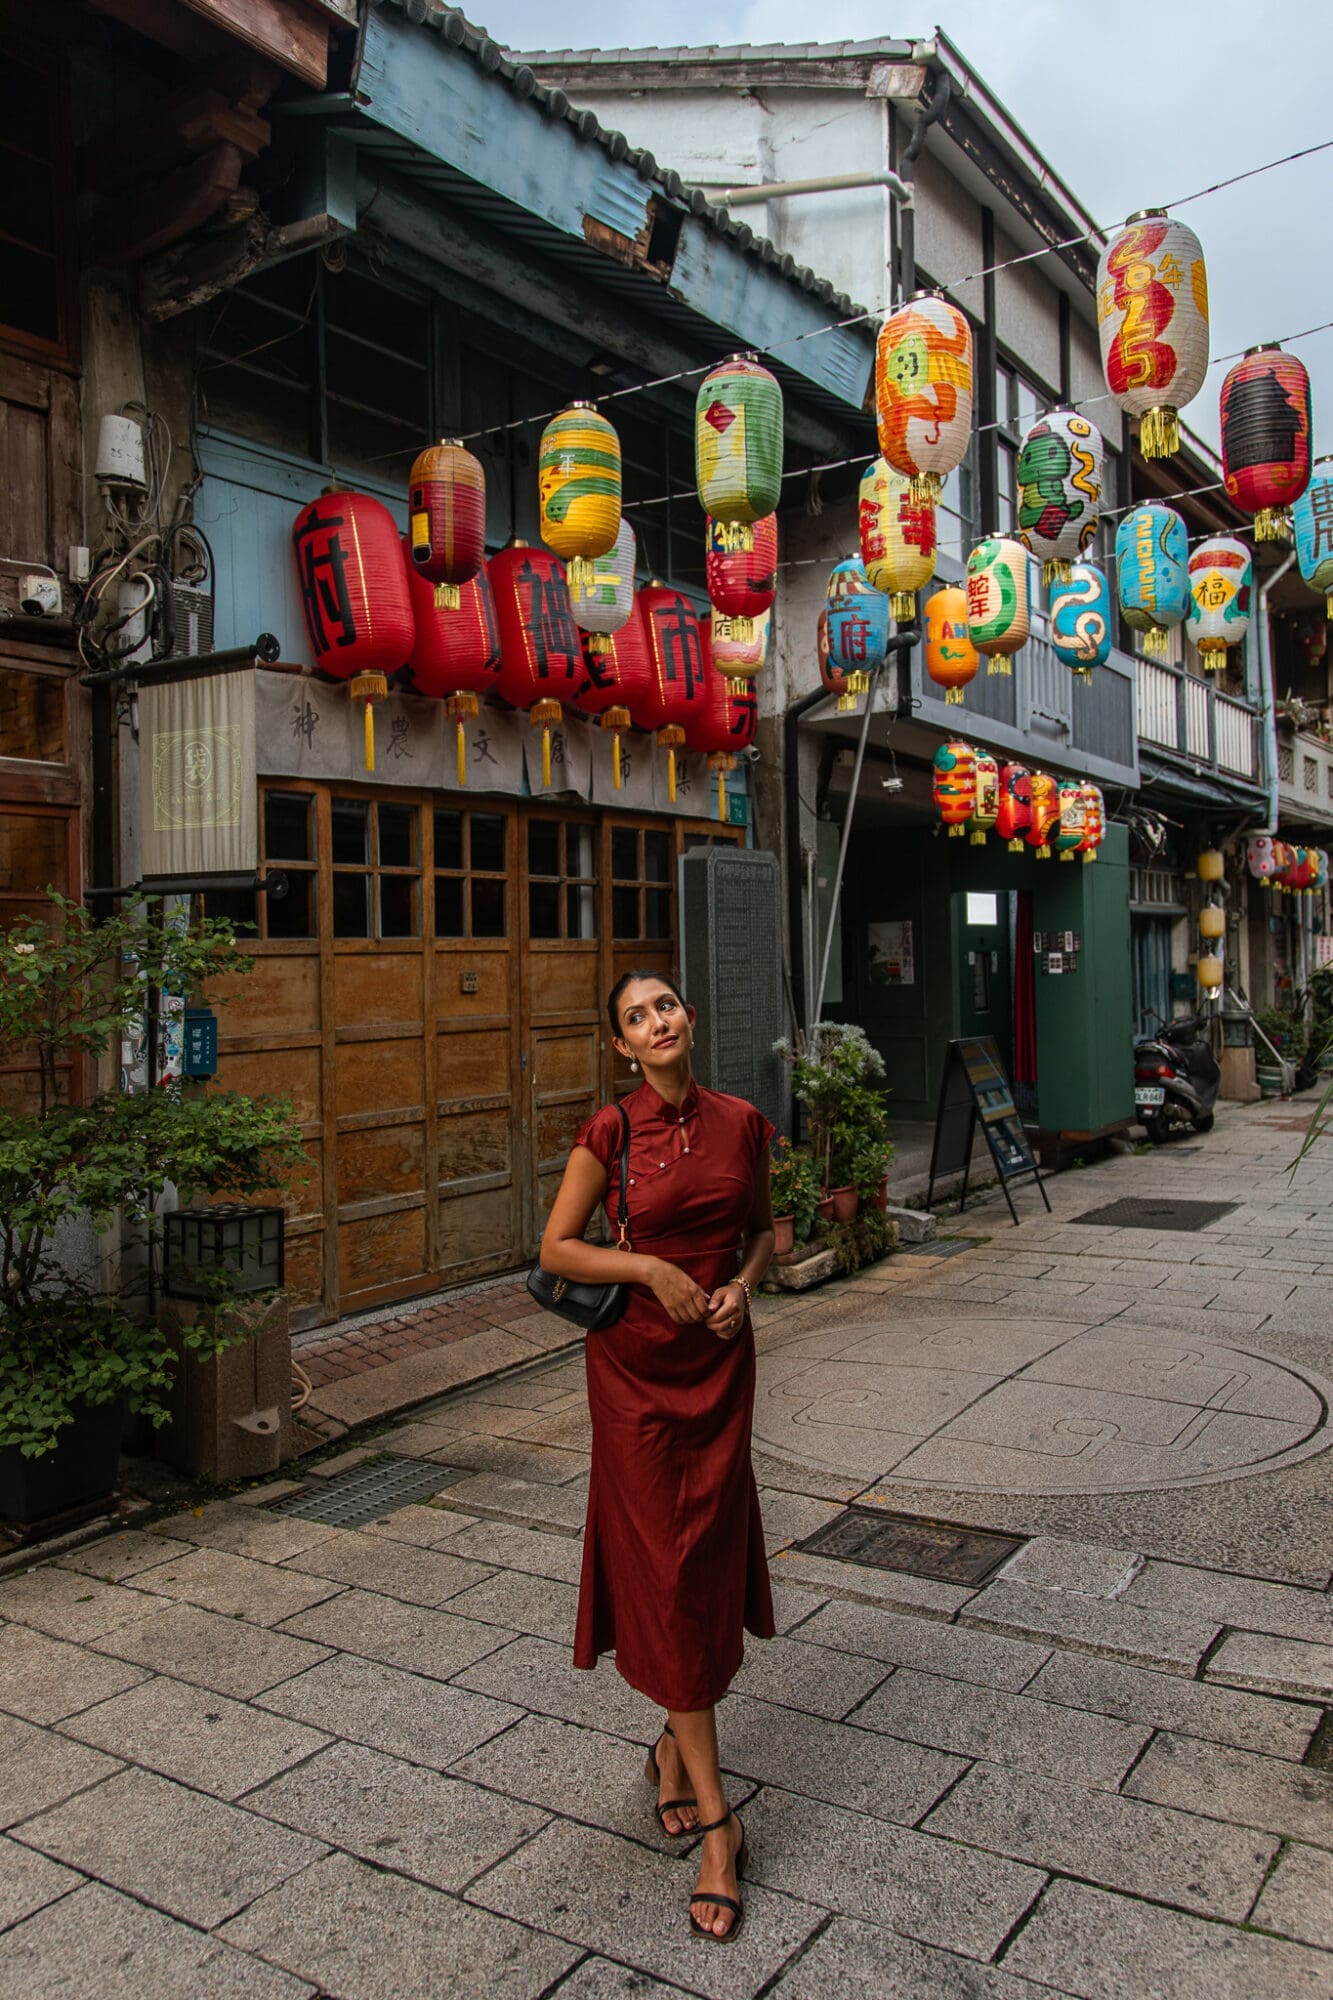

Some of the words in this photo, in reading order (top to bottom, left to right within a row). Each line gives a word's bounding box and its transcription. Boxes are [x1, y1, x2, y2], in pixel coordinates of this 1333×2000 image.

[1114, 224, 1157, 389] 2025
[293, 507, 357, 657] 府
[968, 574, 990, 617] 蛇年
[1196, 576, 1228, 607] 福
[656, 595, 705, 700] 市
[841, 613, 873, 661] 府
